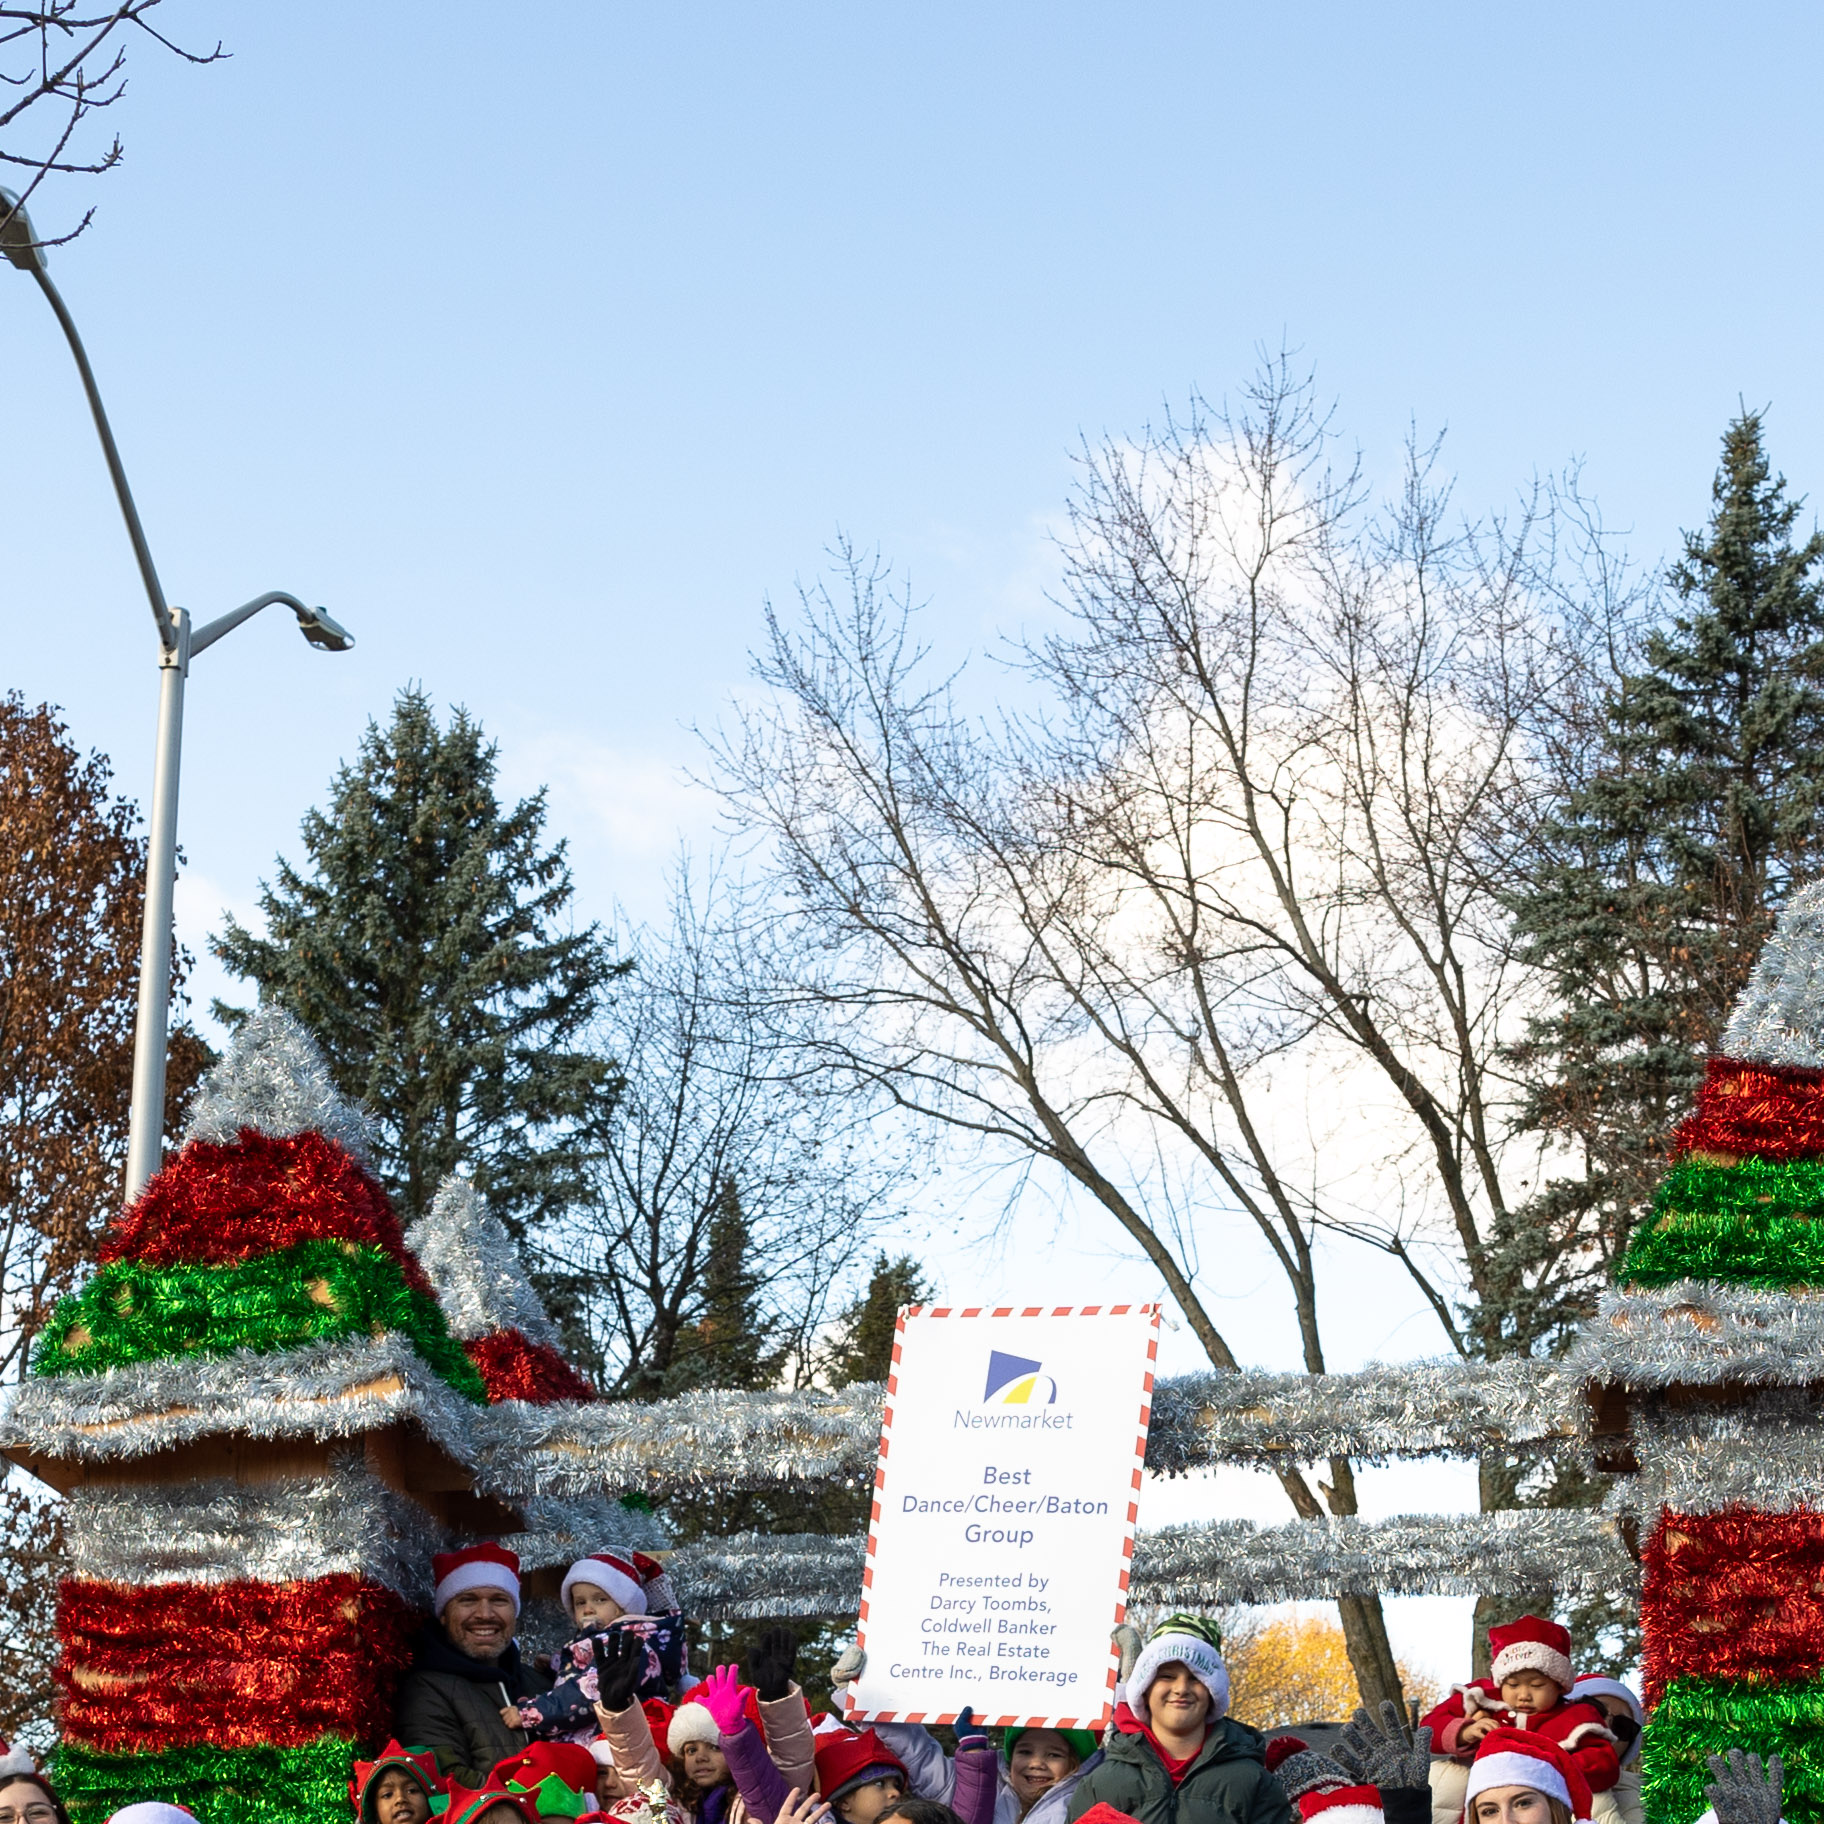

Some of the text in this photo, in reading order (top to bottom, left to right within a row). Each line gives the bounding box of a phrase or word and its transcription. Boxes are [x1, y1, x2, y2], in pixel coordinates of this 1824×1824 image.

[953, 1409, 1074, 1430] Newmarket
[982, 1466, 1033, 1486] Best
[902, 1494, 1109, 1515] Dance/Cheer/Baton
[964, 1523, 1034, 1549] Group
[938, 1572, 1049, 1593] Presented by
[930, 1595, 1052, 1615] Darcy Toombs,
[921, 1618, 1057, 1635] Coldwell Banker
[921, 1640, 1051, 1659] The Real Estate
[889, 1663, 1078, 1687] Centre Inc., Brokerage
